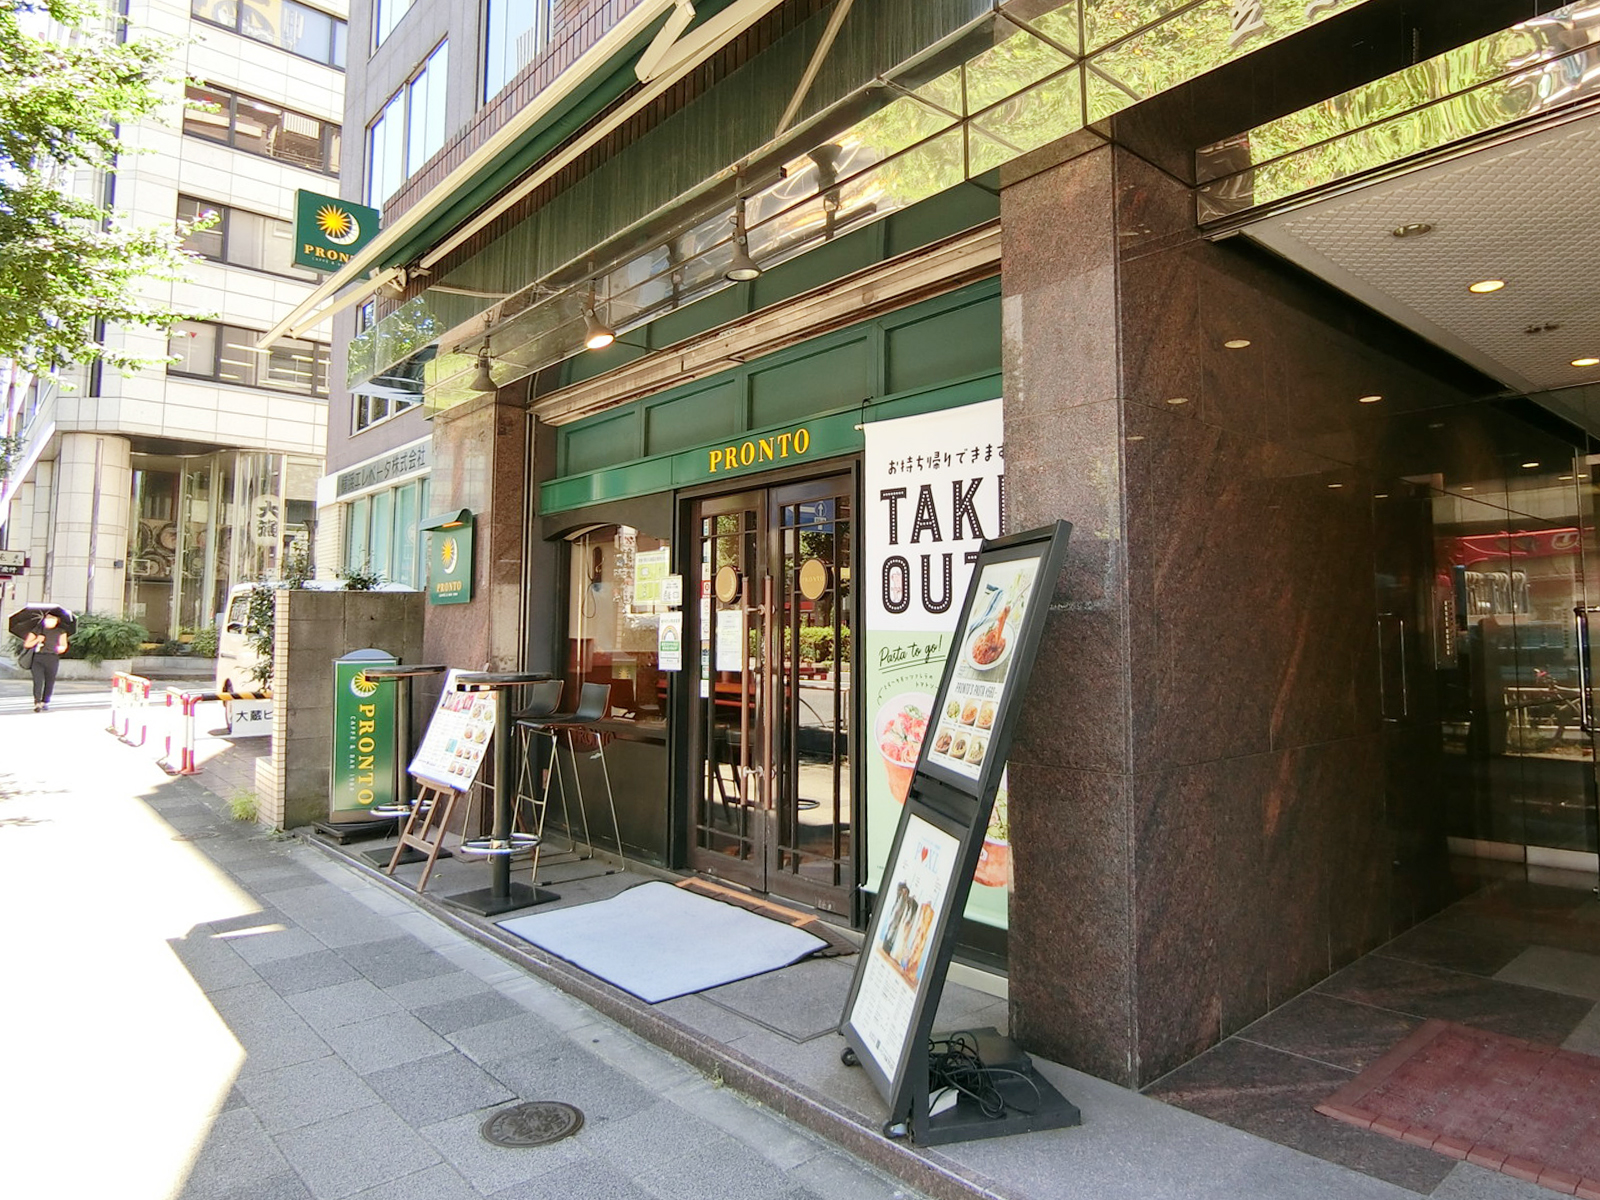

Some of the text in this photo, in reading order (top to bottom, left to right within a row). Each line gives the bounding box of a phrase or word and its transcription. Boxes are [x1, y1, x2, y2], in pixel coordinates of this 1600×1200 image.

[303, 244, 354, 262] PRON
[709, 428, 810, 473] PRONTO
[437, 581, 462, 592] PRONTO
[879, 634, 943, 667] Pasta to go!
[357, 704, 375, 805] PRONTO
